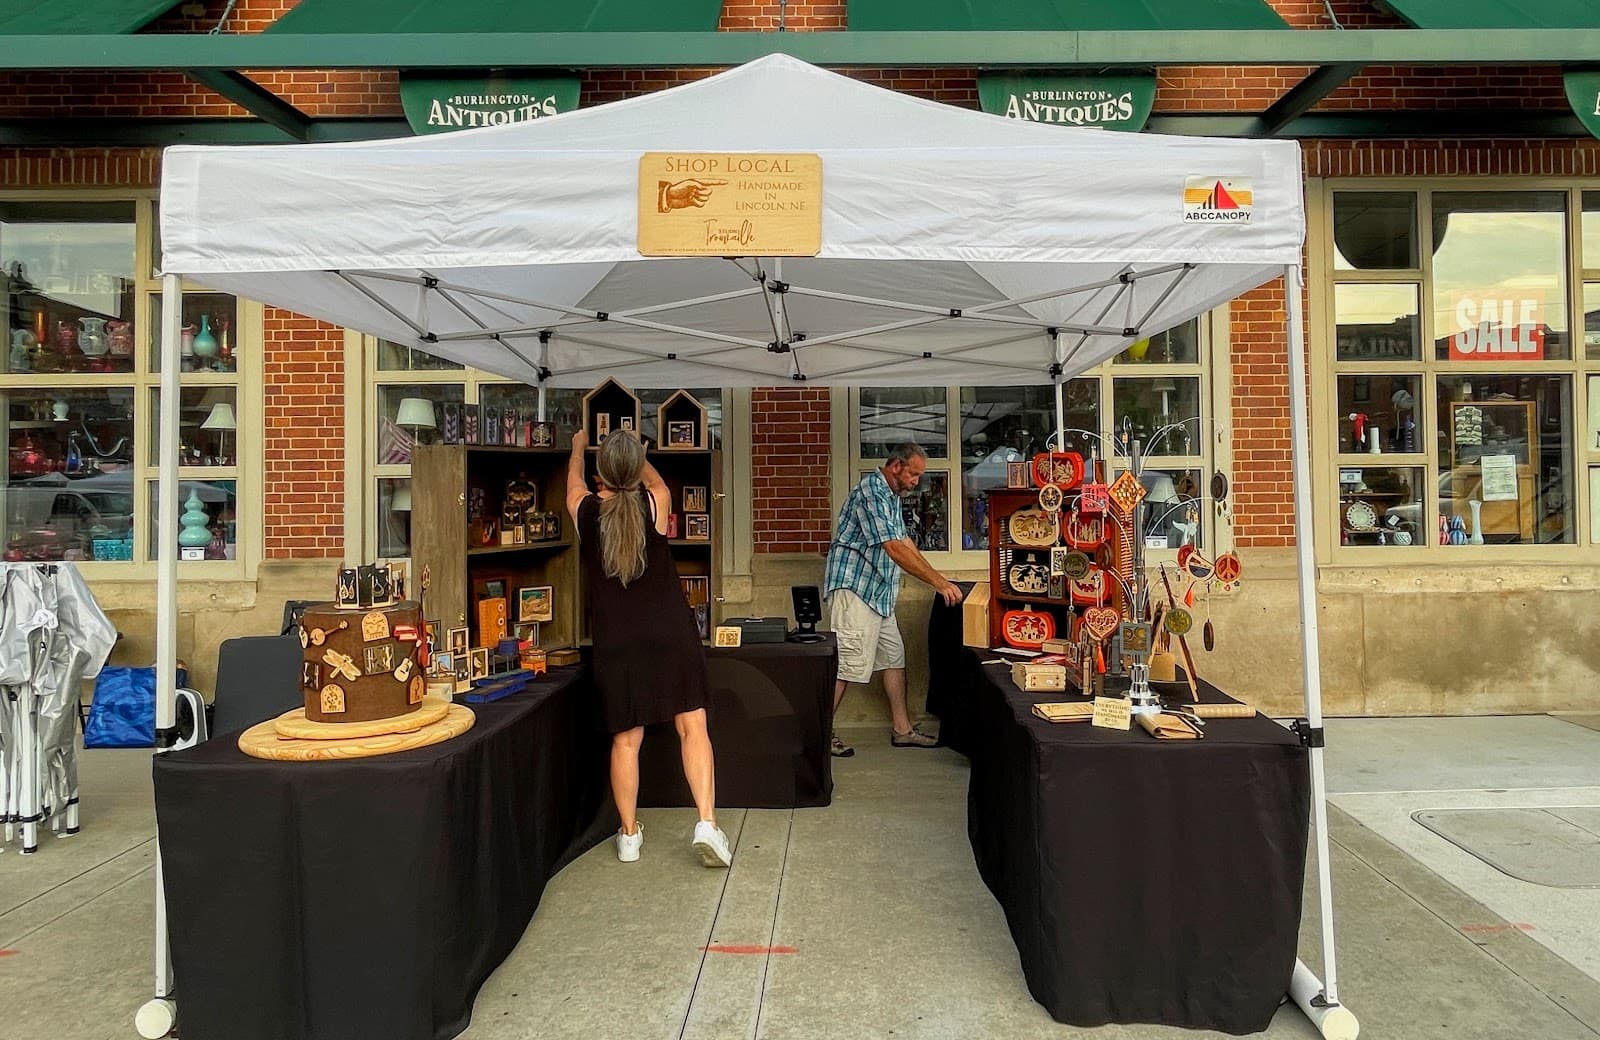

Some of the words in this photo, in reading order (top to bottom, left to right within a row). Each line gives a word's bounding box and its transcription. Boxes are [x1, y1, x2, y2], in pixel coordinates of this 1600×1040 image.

[455, 95, 529, 104] BURLINGTON
[1032, 91, 1105, 100] BURLINGTON
[427, 95, 558, 127] ANTIQUES
[1005, 92, 1133, 125] ANTIQUES
[665, 156, 719, 173] SHOP
[727, 157, 794, 173] LOCAL
[738, 181, 804, 191] HANDMADE
[765, 192, 777, 200] IN
[790, 201, 807, 210] NE
[1185, 212, 1251, 220] ABCCANOPY
[1455, 298, 1537, 354] SALE
